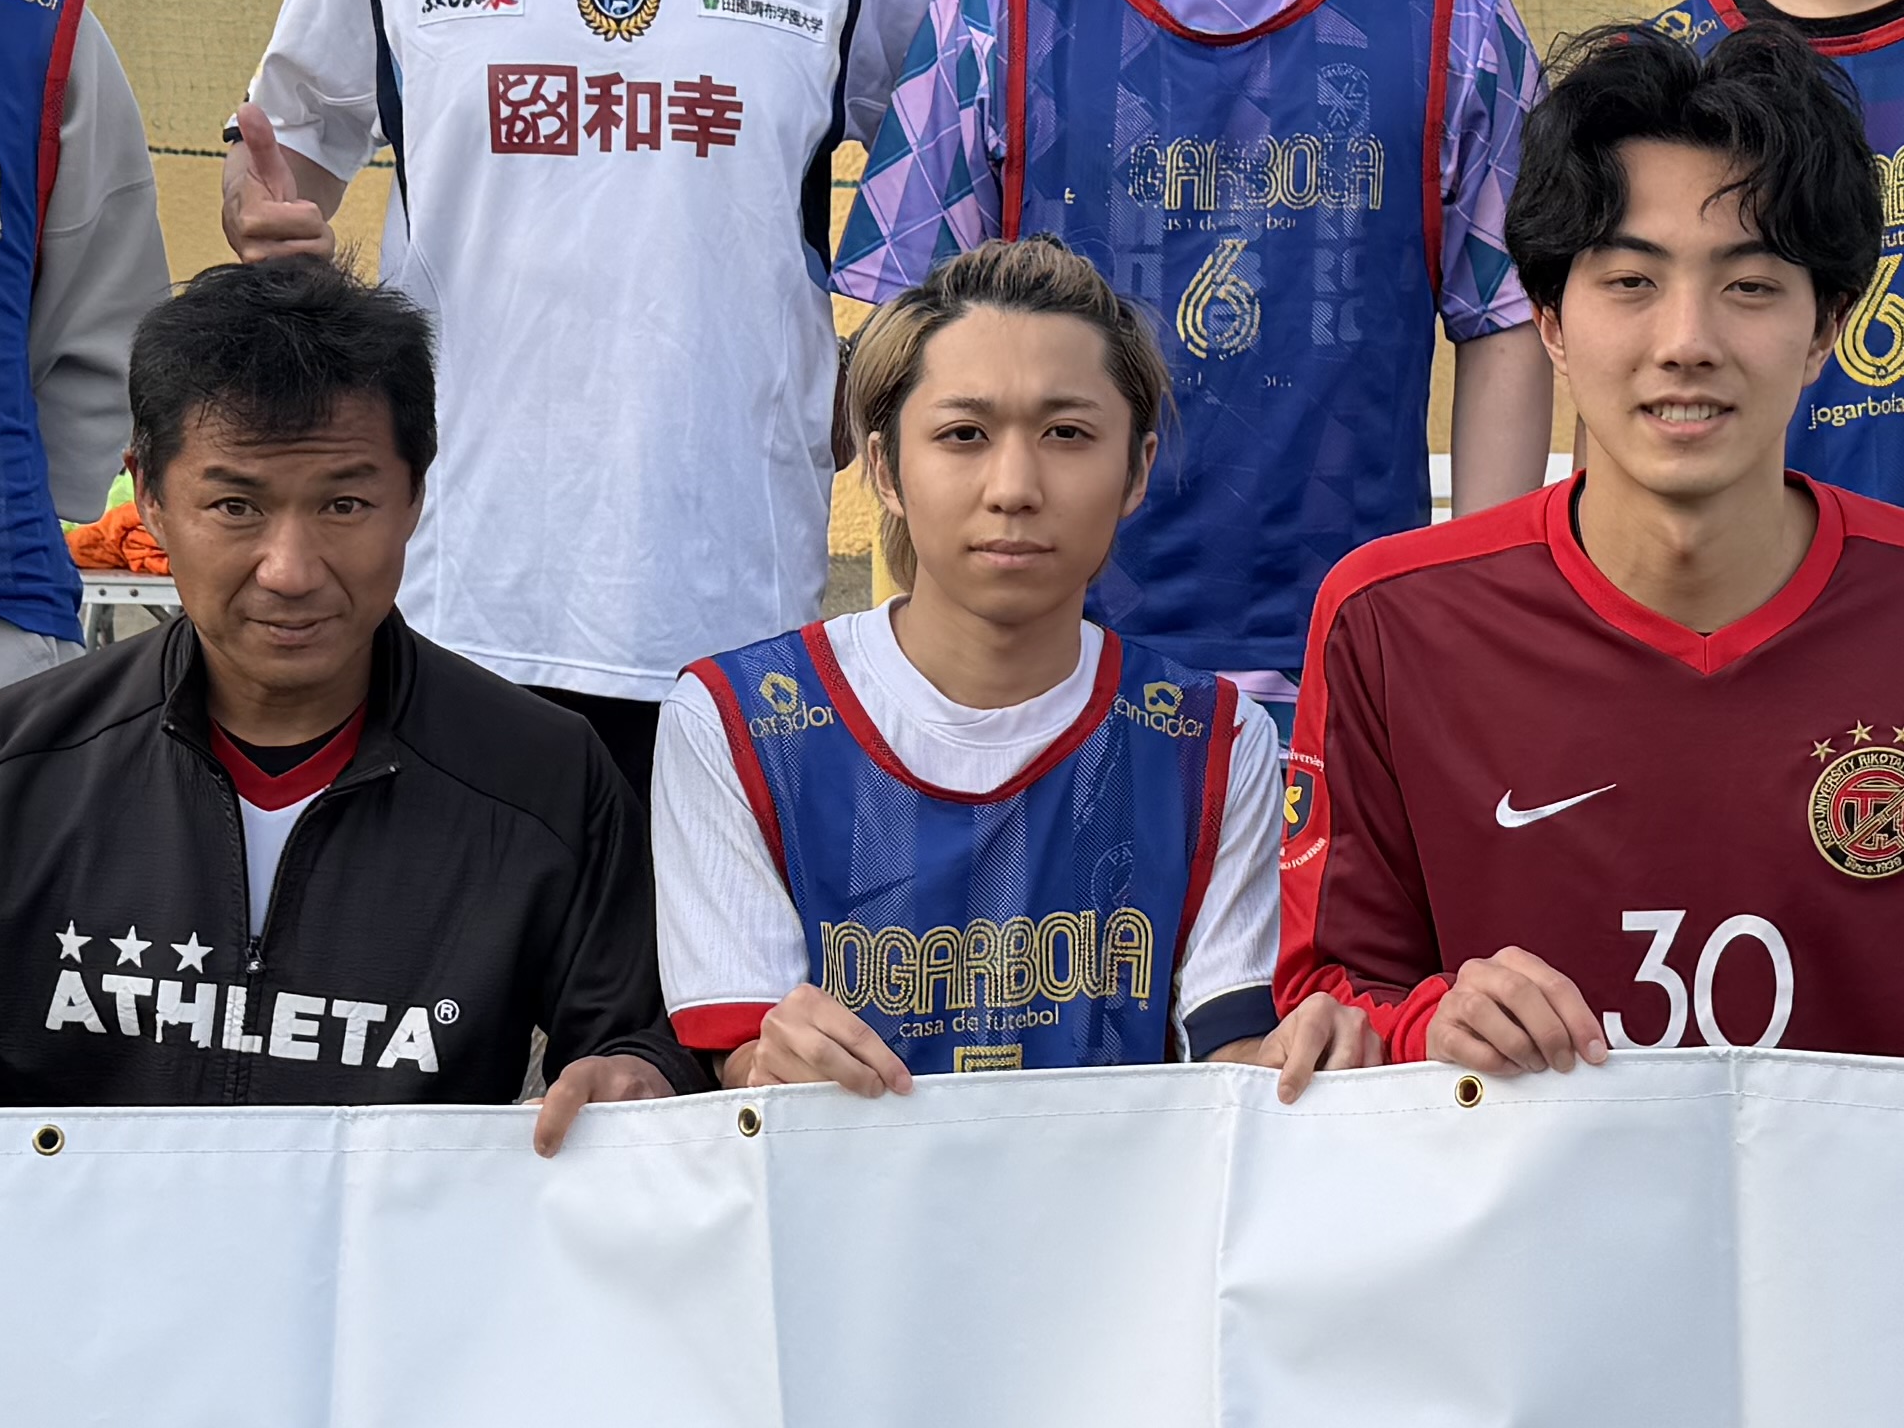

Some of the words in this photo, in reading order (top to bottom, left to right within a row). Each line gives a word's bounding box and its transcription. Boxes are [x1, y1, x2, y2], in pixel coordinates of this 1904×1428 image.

[583, 72, 744, 158] 和幸
[1176, 238, 1261, 360] 6
[1814, 757, 1855, 819] UNIVERSITY
[1814, 820, 1836, 849] KEIO
[820, 906, 1154, 1016] JOGARBOLA
[1603, 909, 1794, 1048] 30
[899, 1019, 946, 1039] casa
[951, 1010, 980, 1033] de
[985, 1003, 1060, 1032] futebol
